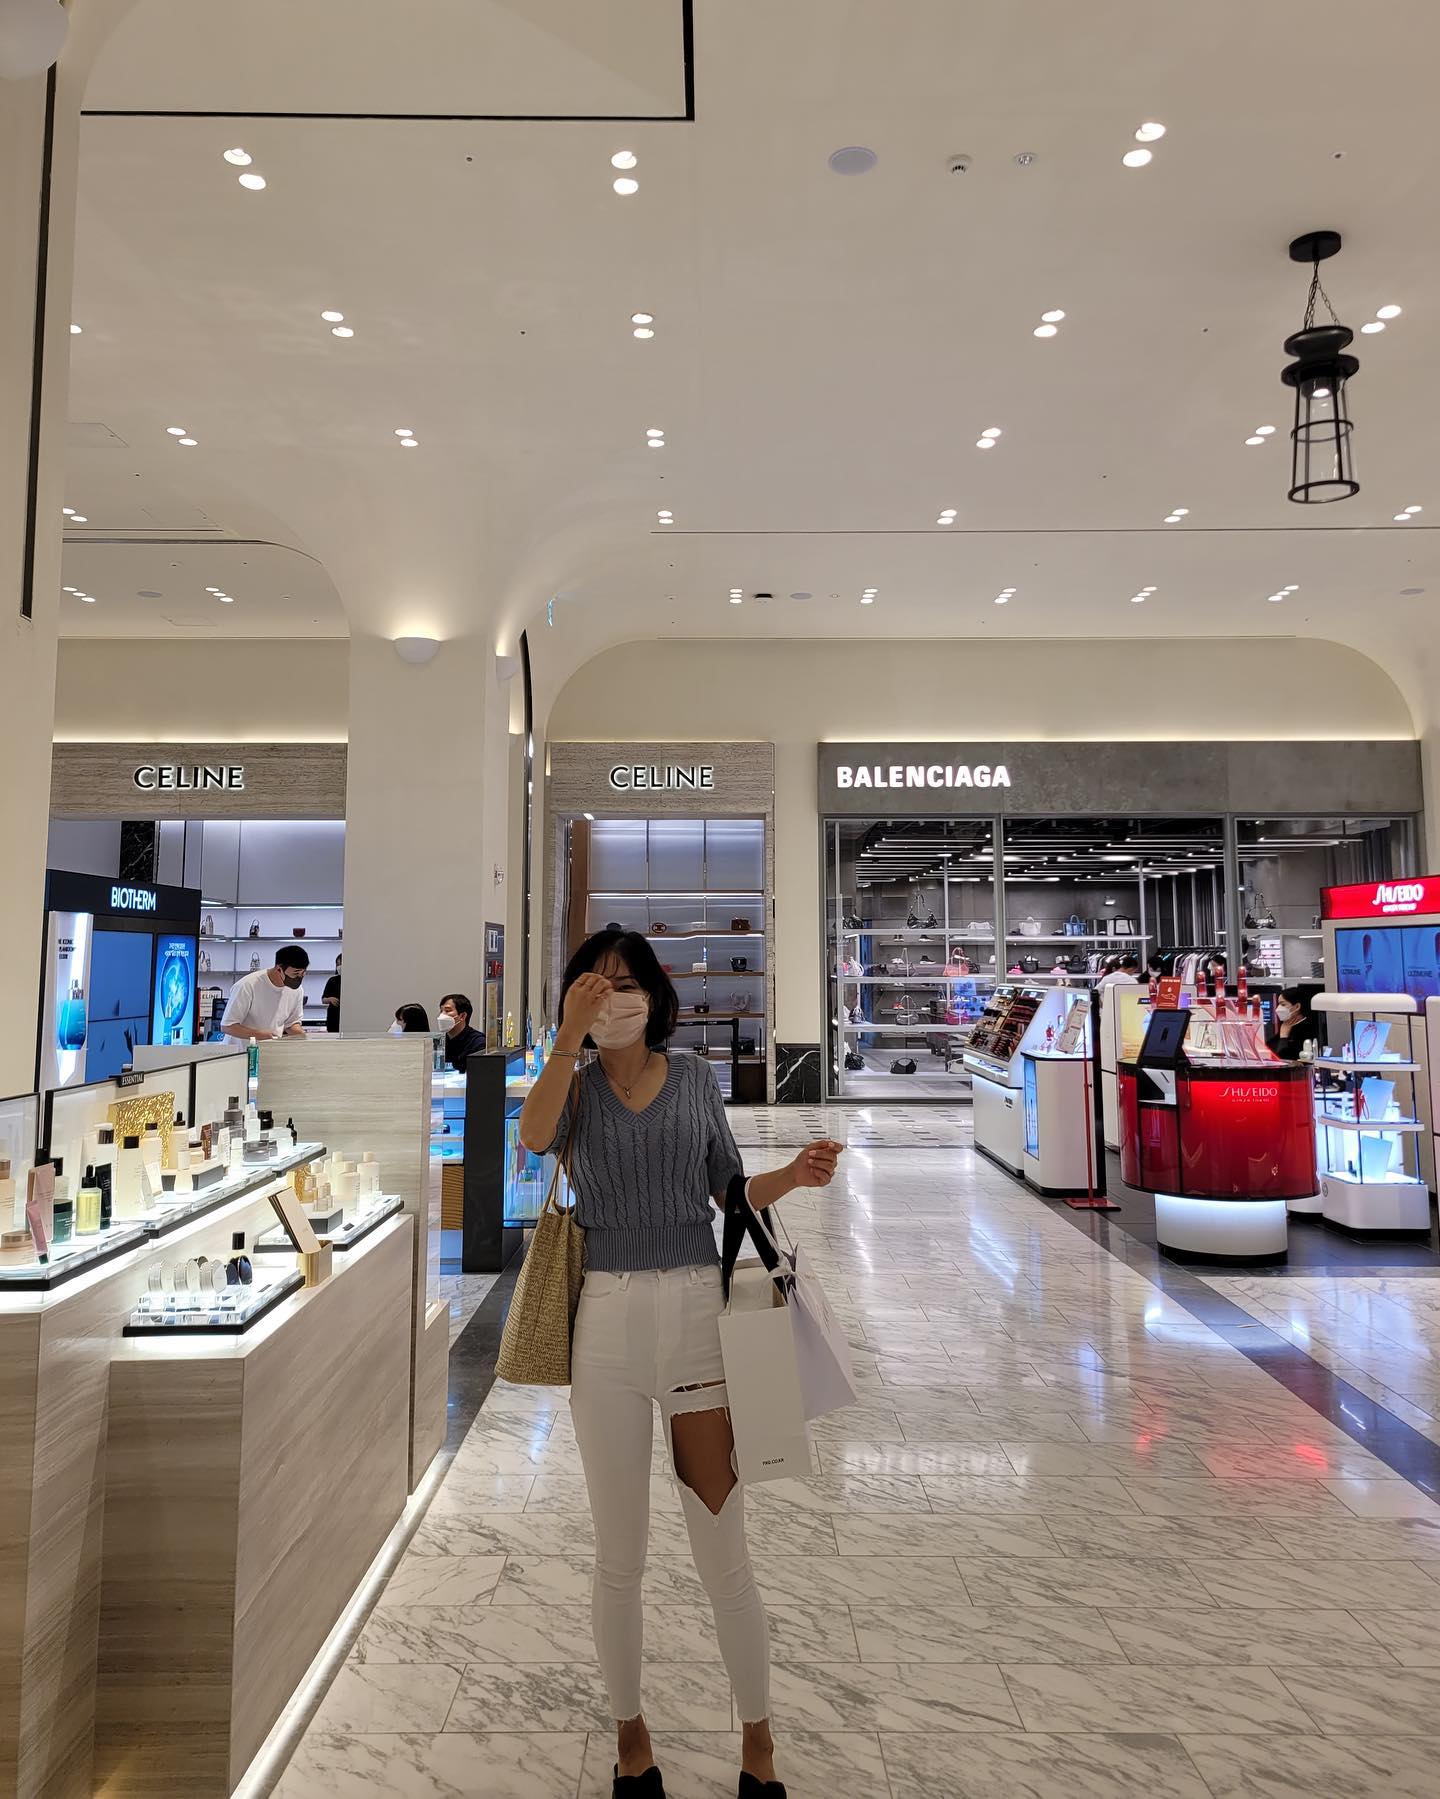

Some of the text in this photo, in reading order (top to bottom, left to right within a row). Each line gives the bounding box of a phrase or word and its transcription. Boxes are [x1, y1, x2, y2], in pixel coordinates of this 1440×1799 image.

[133, 765, 244, 790] CELINE
[609, 765, 714, 790] CELINE
[836, 765, 1012, 788] BALENCIAGA
[111, 886, 156, 911] BIOTHERM
[1372, 883, 1424, 905] SHISEIDO
[1218, 1086, 1278, 1097] SHISEIDO
